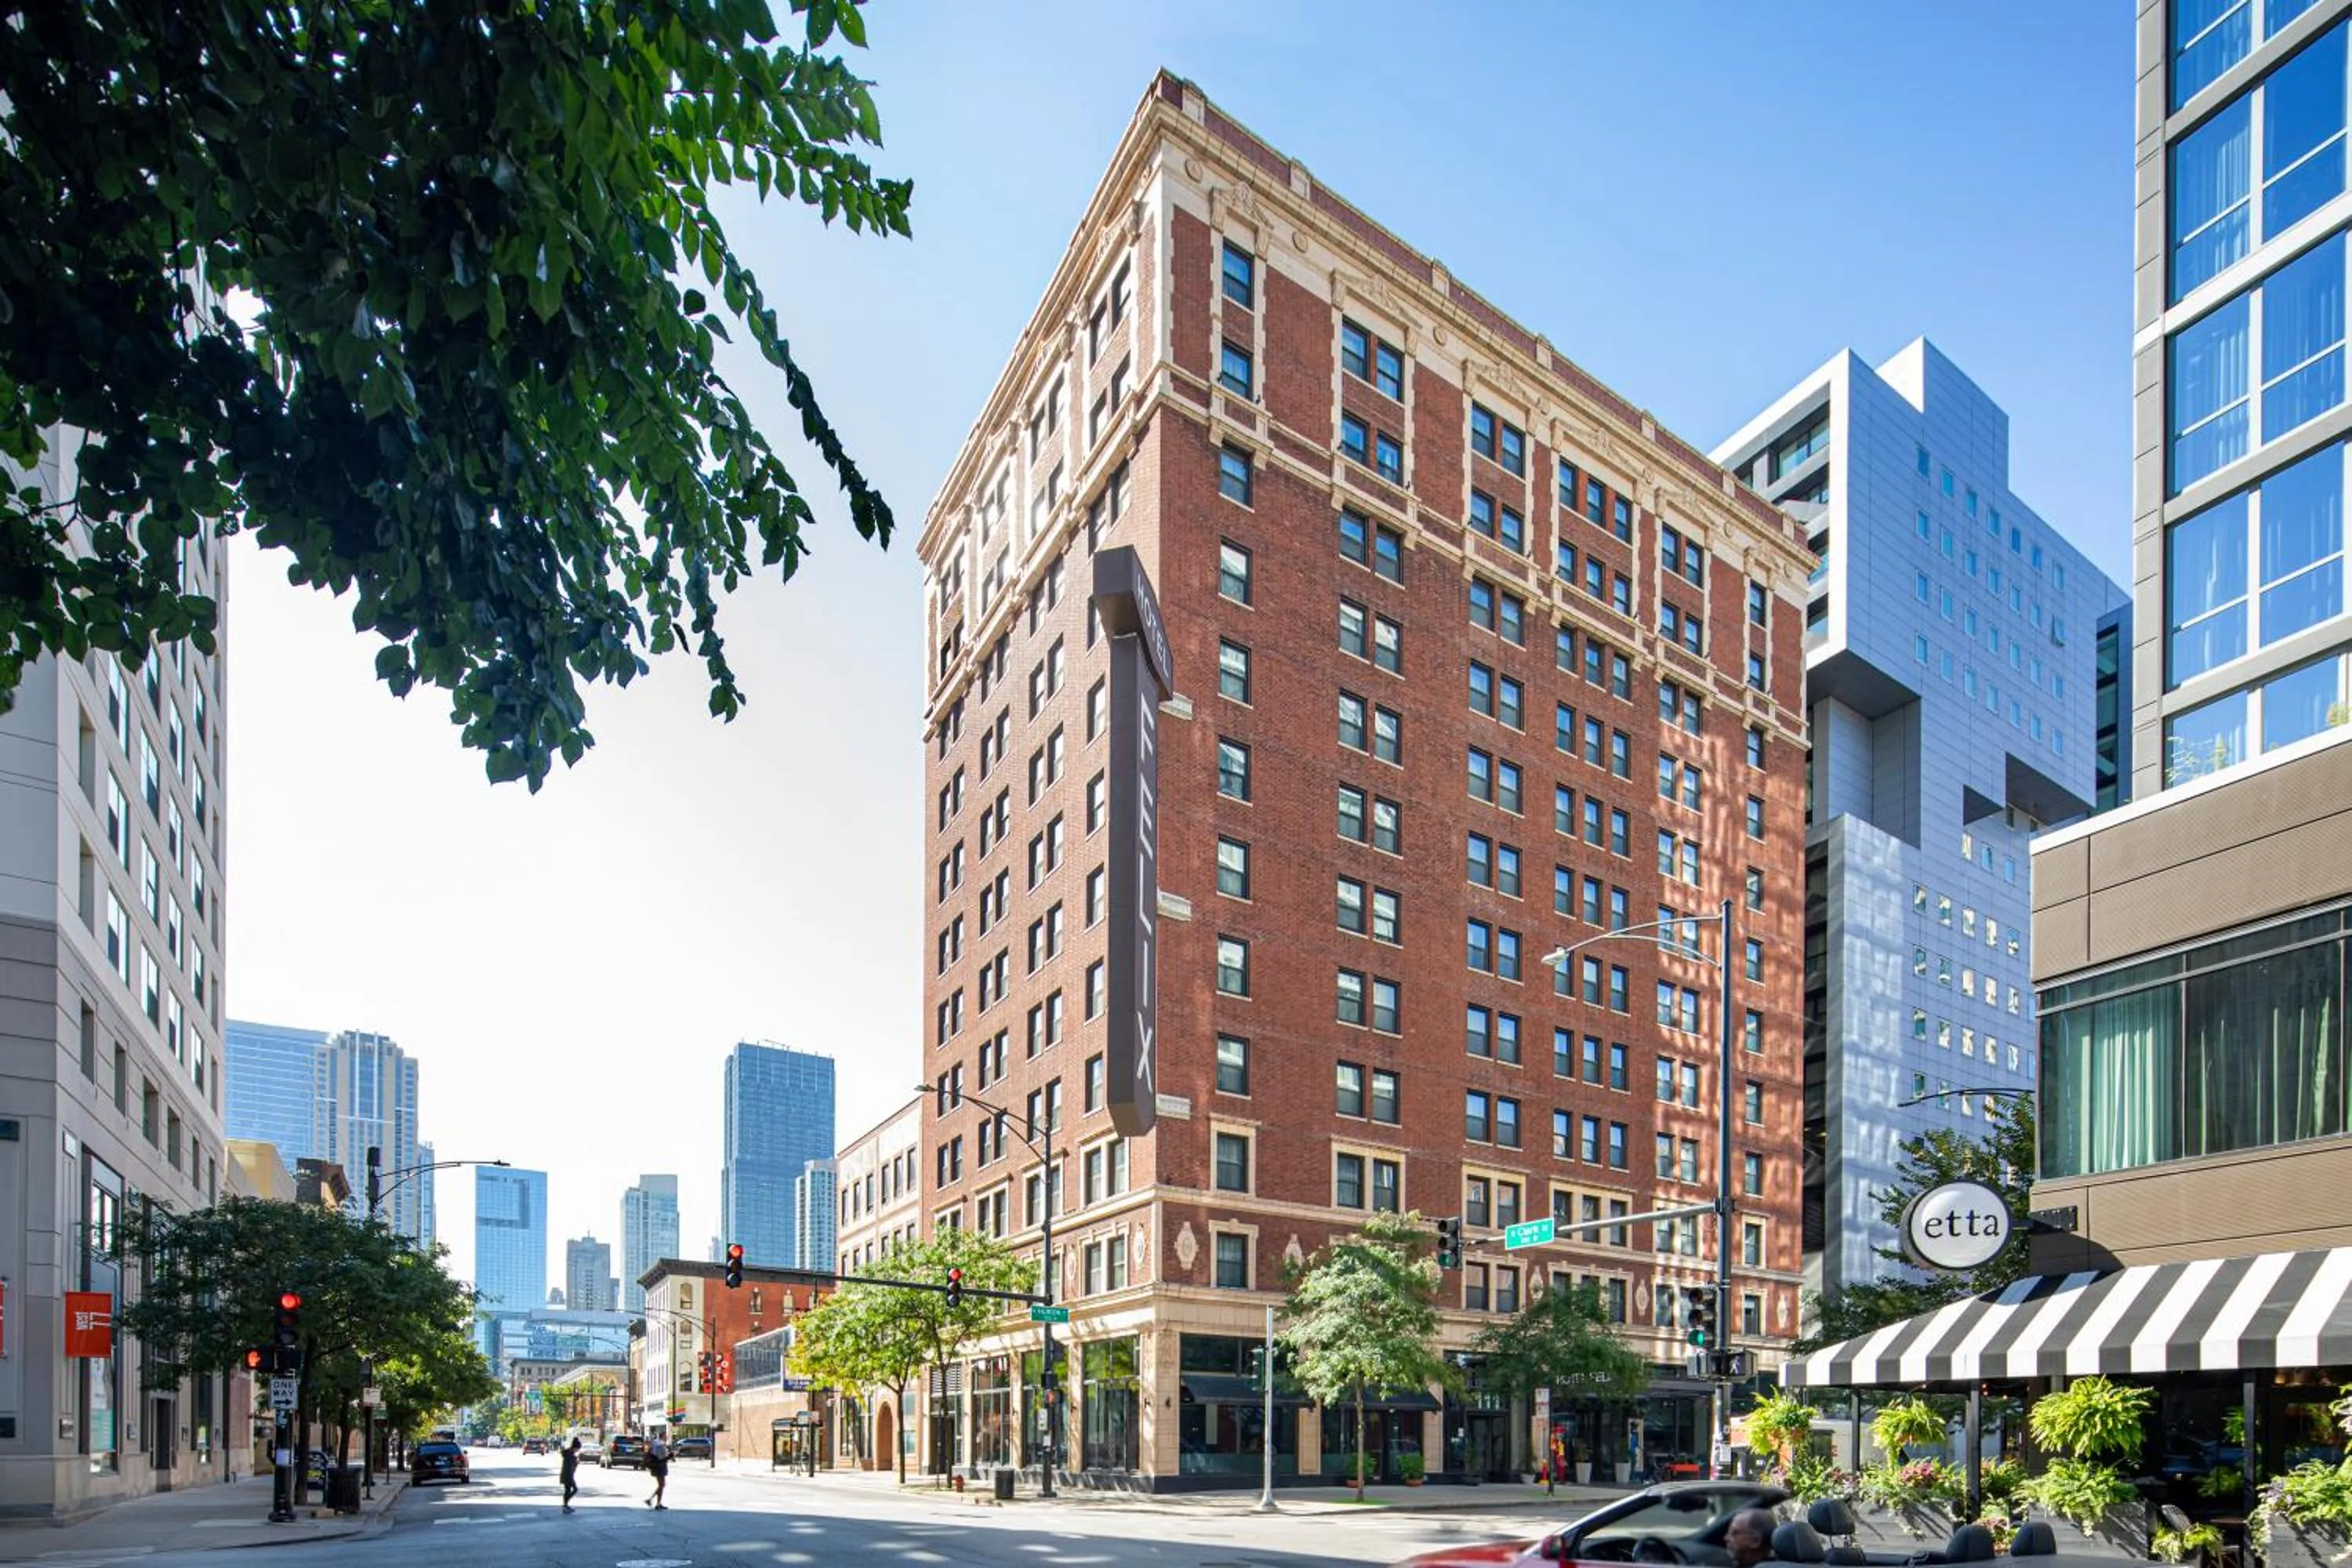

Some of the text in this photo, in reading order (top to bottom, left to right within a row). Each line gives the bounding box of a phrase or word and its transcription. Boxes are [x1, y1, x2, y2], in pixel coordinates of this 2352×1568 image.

[1137, 574, 1169, 678] HOTEL
[1137, 692, 1155, 1093] FELIX
[1924, 1209, 2000, 1238] etta
[273, 1388, 295, 1397] WAY
